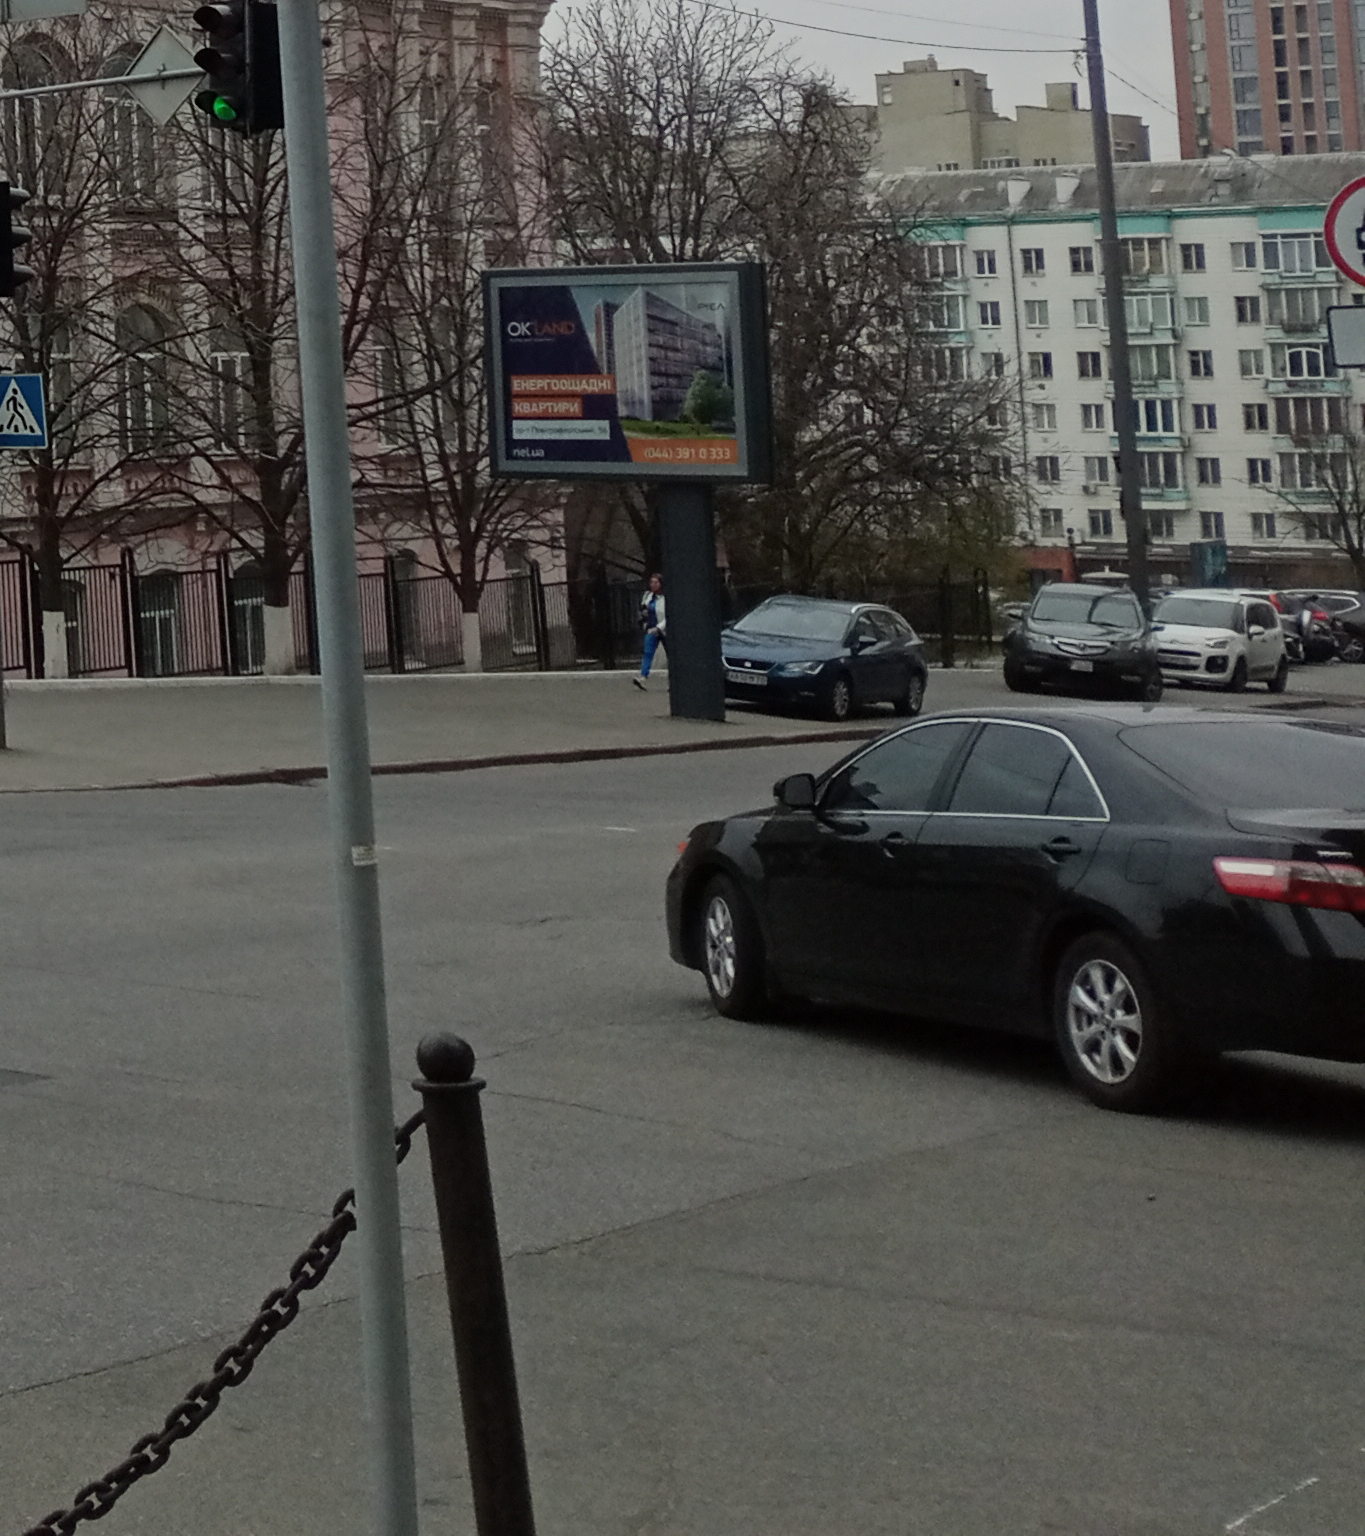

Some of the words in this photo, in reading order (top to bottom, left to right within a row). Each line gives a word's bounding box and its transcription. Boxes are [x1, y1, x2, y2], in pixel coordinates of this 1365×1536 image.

[513, 379, 611, 392] ЕНЕРГООЩАДНІ
[514, 402, 579, 413] КВАРТИРИ
[644, 447, 673, 459] (044)
[676, 448, 695, 459] 391
[699, 448, 707, 459] 0
[710, 448, 731, 459] 333
